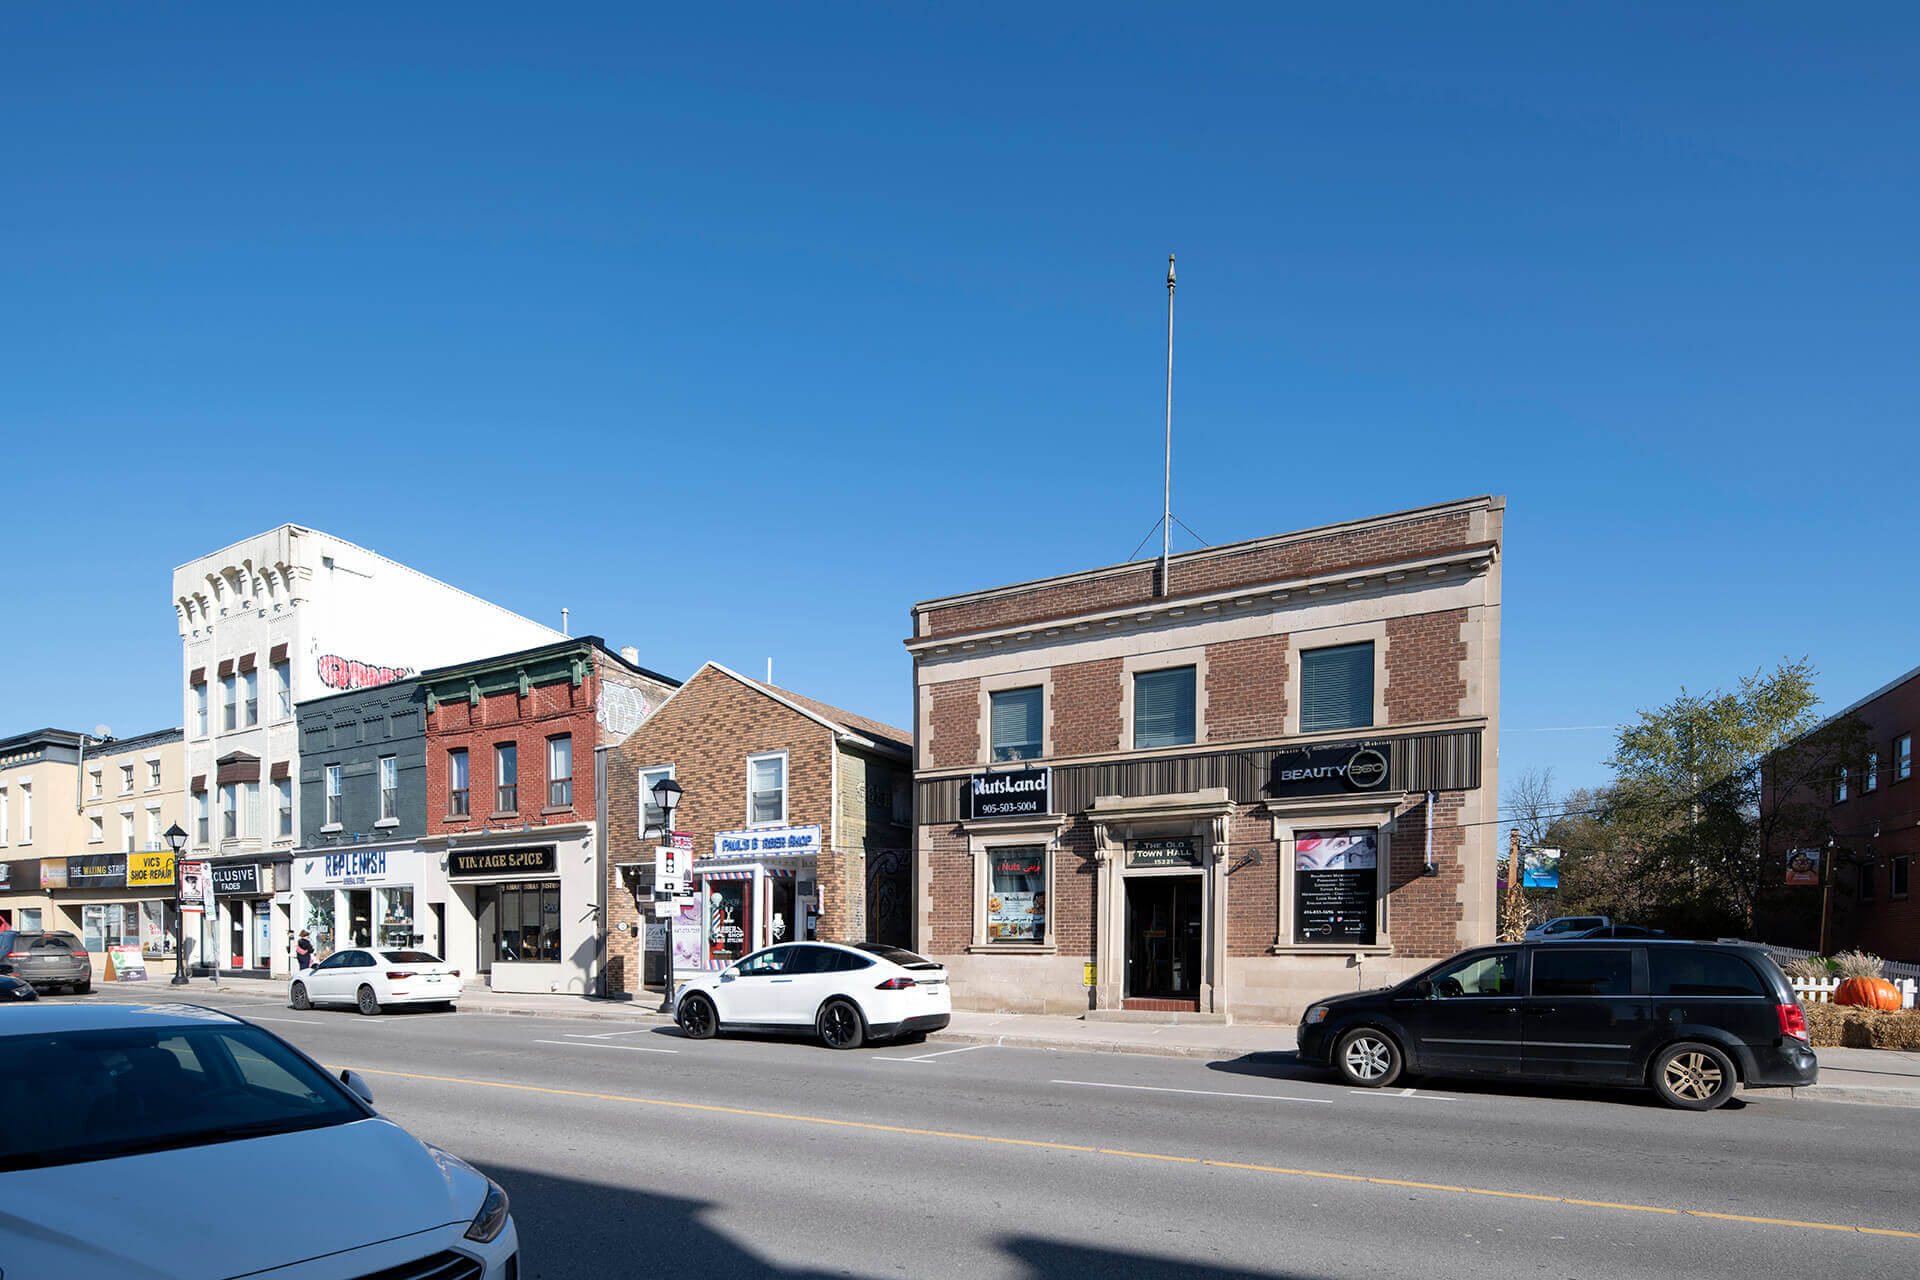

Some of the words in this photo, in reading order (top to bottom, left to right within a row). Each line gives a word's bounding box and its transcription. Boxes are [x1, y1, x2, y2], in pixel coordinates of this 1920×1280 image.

[1281, 765, 1347, 780] BEAUTY
[974, 773, 1047, 795] NutsLand
[982, 801, 1037, 813] 905-503-5004
[751, 837, 786, 850] BRBER
[788, 835, 812, 848] SHOP
[1166, 848, 1192, 856] HALL
[143, 858, 160, 867] VIC'S
[325, 851, 386, 876] REPLENISH
[458, 854, 507, 869] VINTAGE
[508, 852, 543, 866] SPICE
[1001, 862, 1021, 871] Nuts
[70, 866, 82, 875] THE
[107, 864, 126, 874] STRIP
[130, 870, 148, 880] SHOE
[149, 869, 172, 879] REPAIR
[212, 869, 255, 882] CLUSIVE
